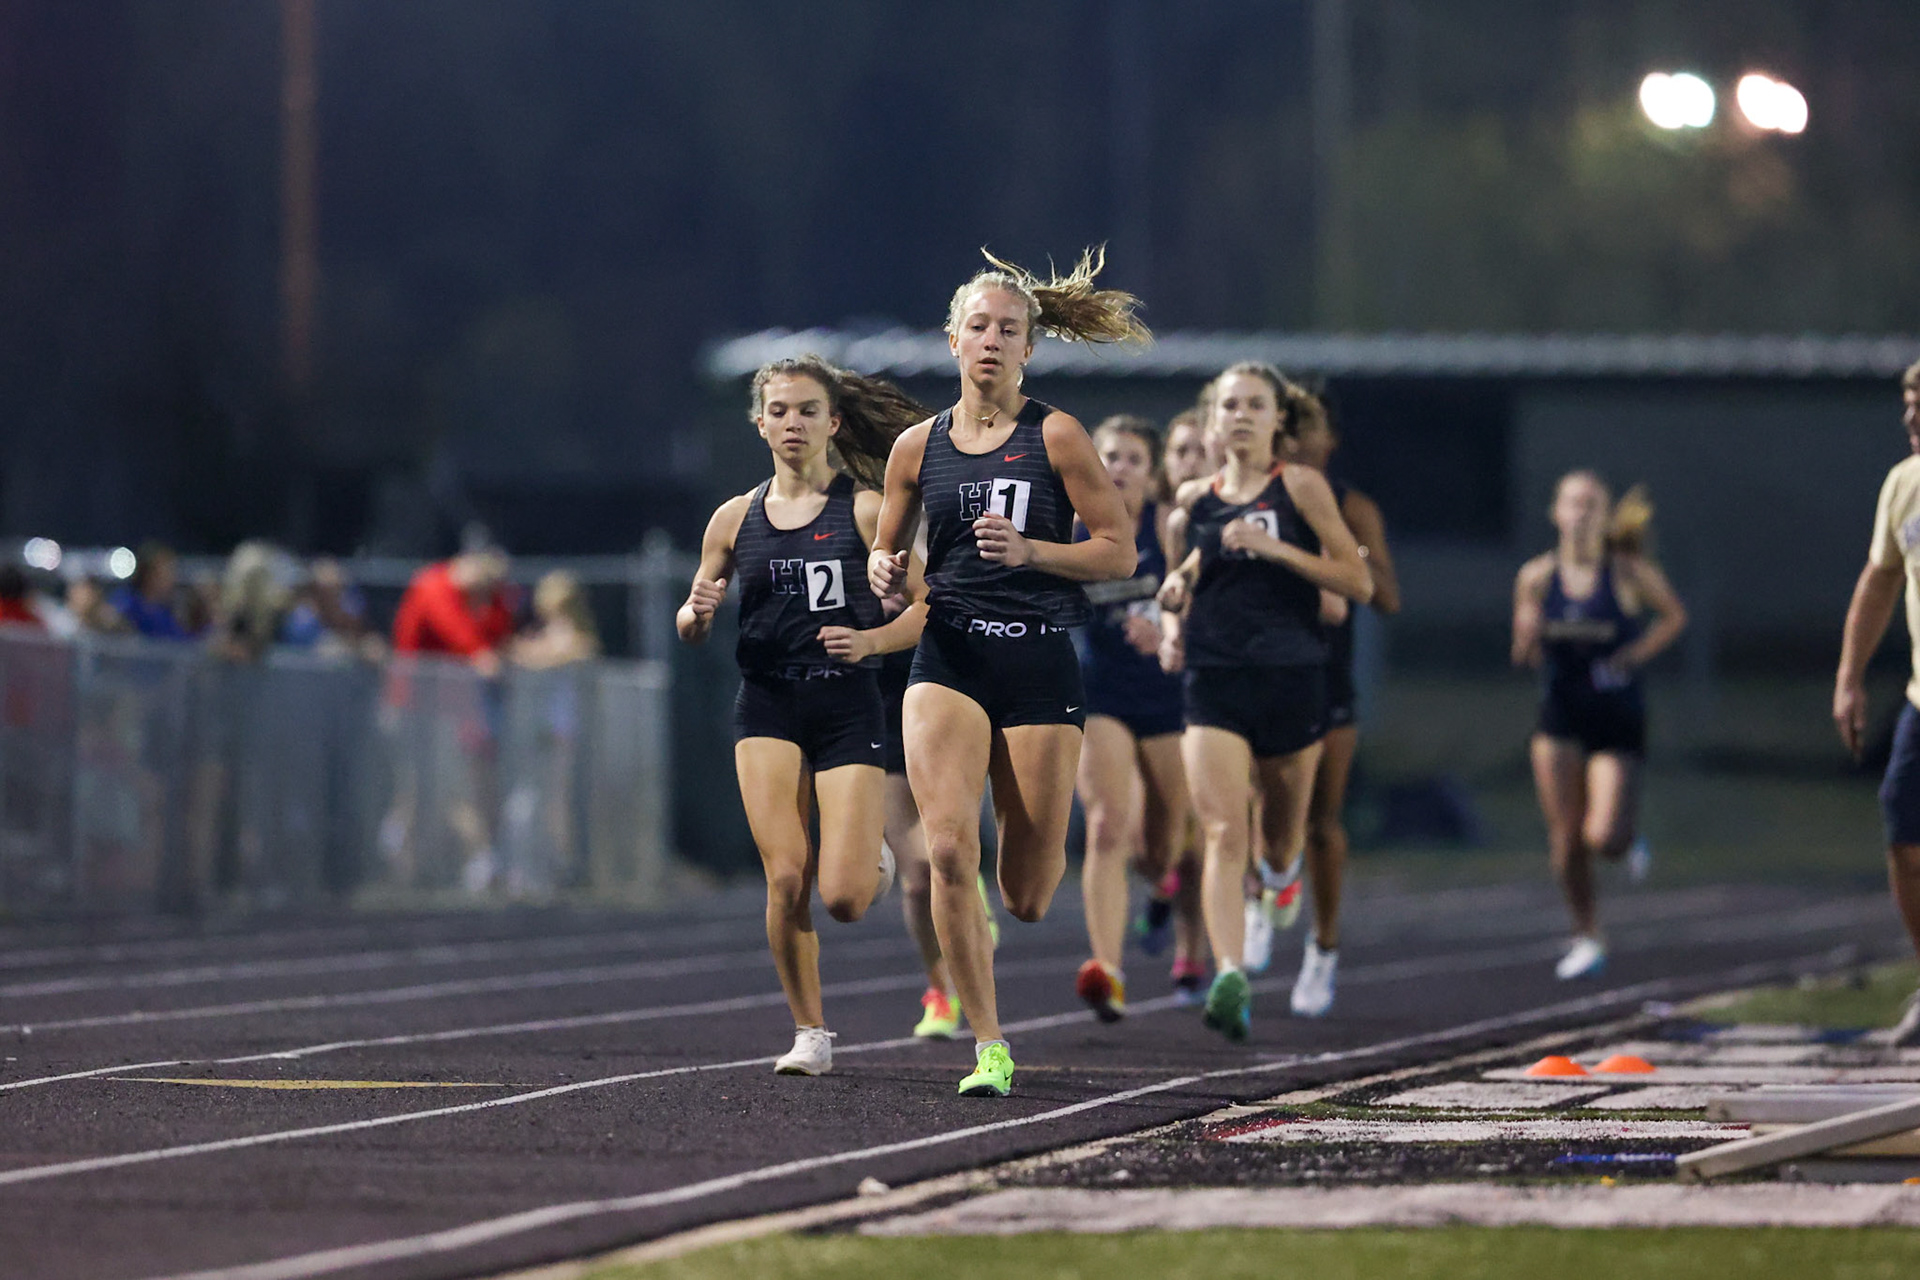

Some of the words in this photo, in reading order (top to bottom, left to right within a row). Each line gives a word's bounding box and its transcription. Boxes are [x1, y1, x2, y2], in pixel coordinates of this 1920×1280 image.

[959, 481, 993, 521] H
[998, 483, 1017, 521] 1
[770, 558, 805, 595] H
[813, 564, 838, 608] 2
[967, 618, 1028, 638] PRO
